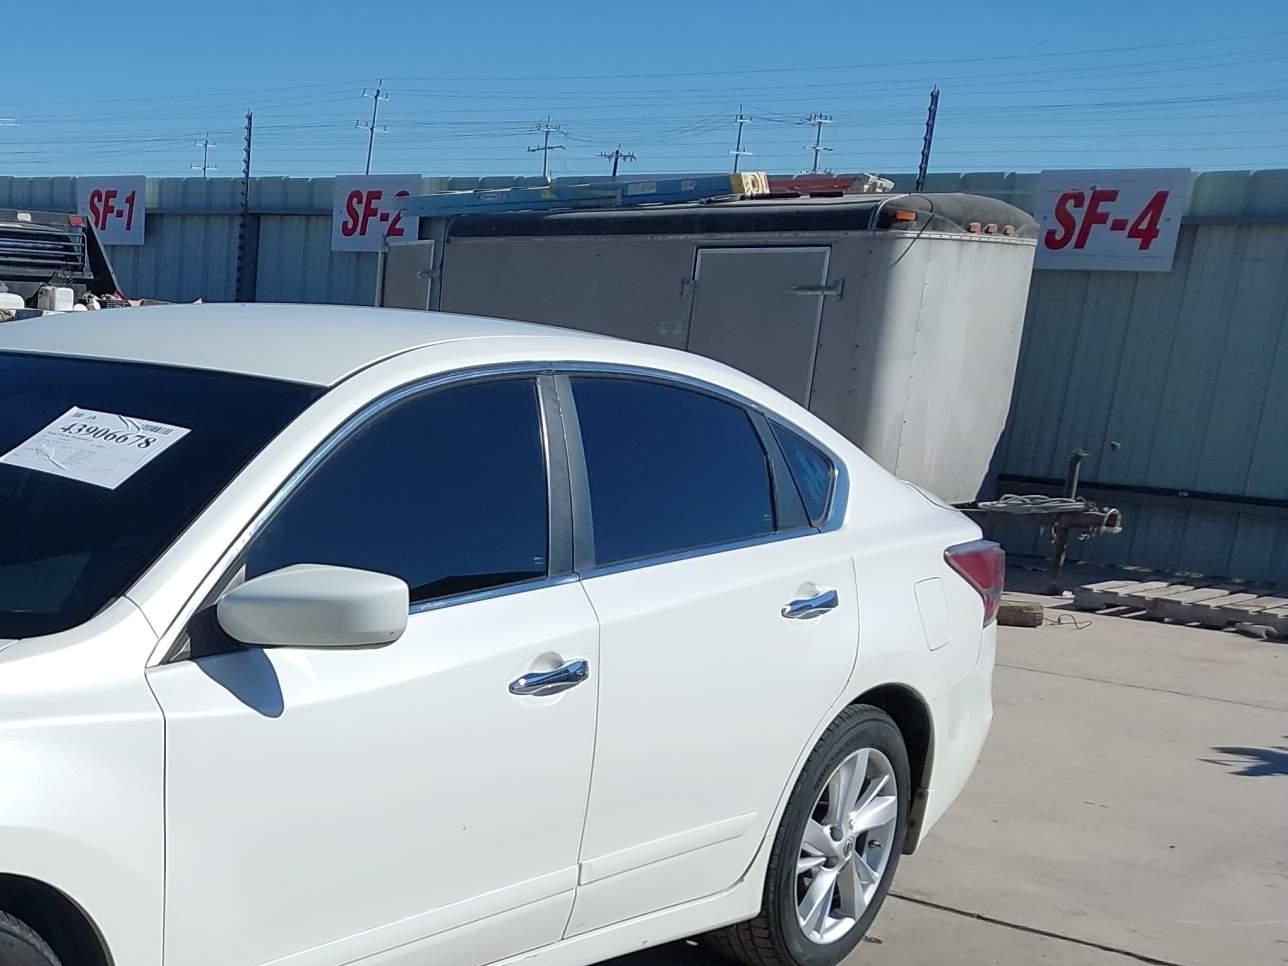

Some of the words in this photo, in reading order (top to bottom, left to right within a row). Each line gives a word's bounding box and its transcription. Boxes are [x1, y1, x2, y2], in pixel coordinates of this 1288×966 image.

[90, 189, 136, 231] SF-1
[1045, 190, 1170, 250] SF-4
[60, 422, 157, 449] 43906678
